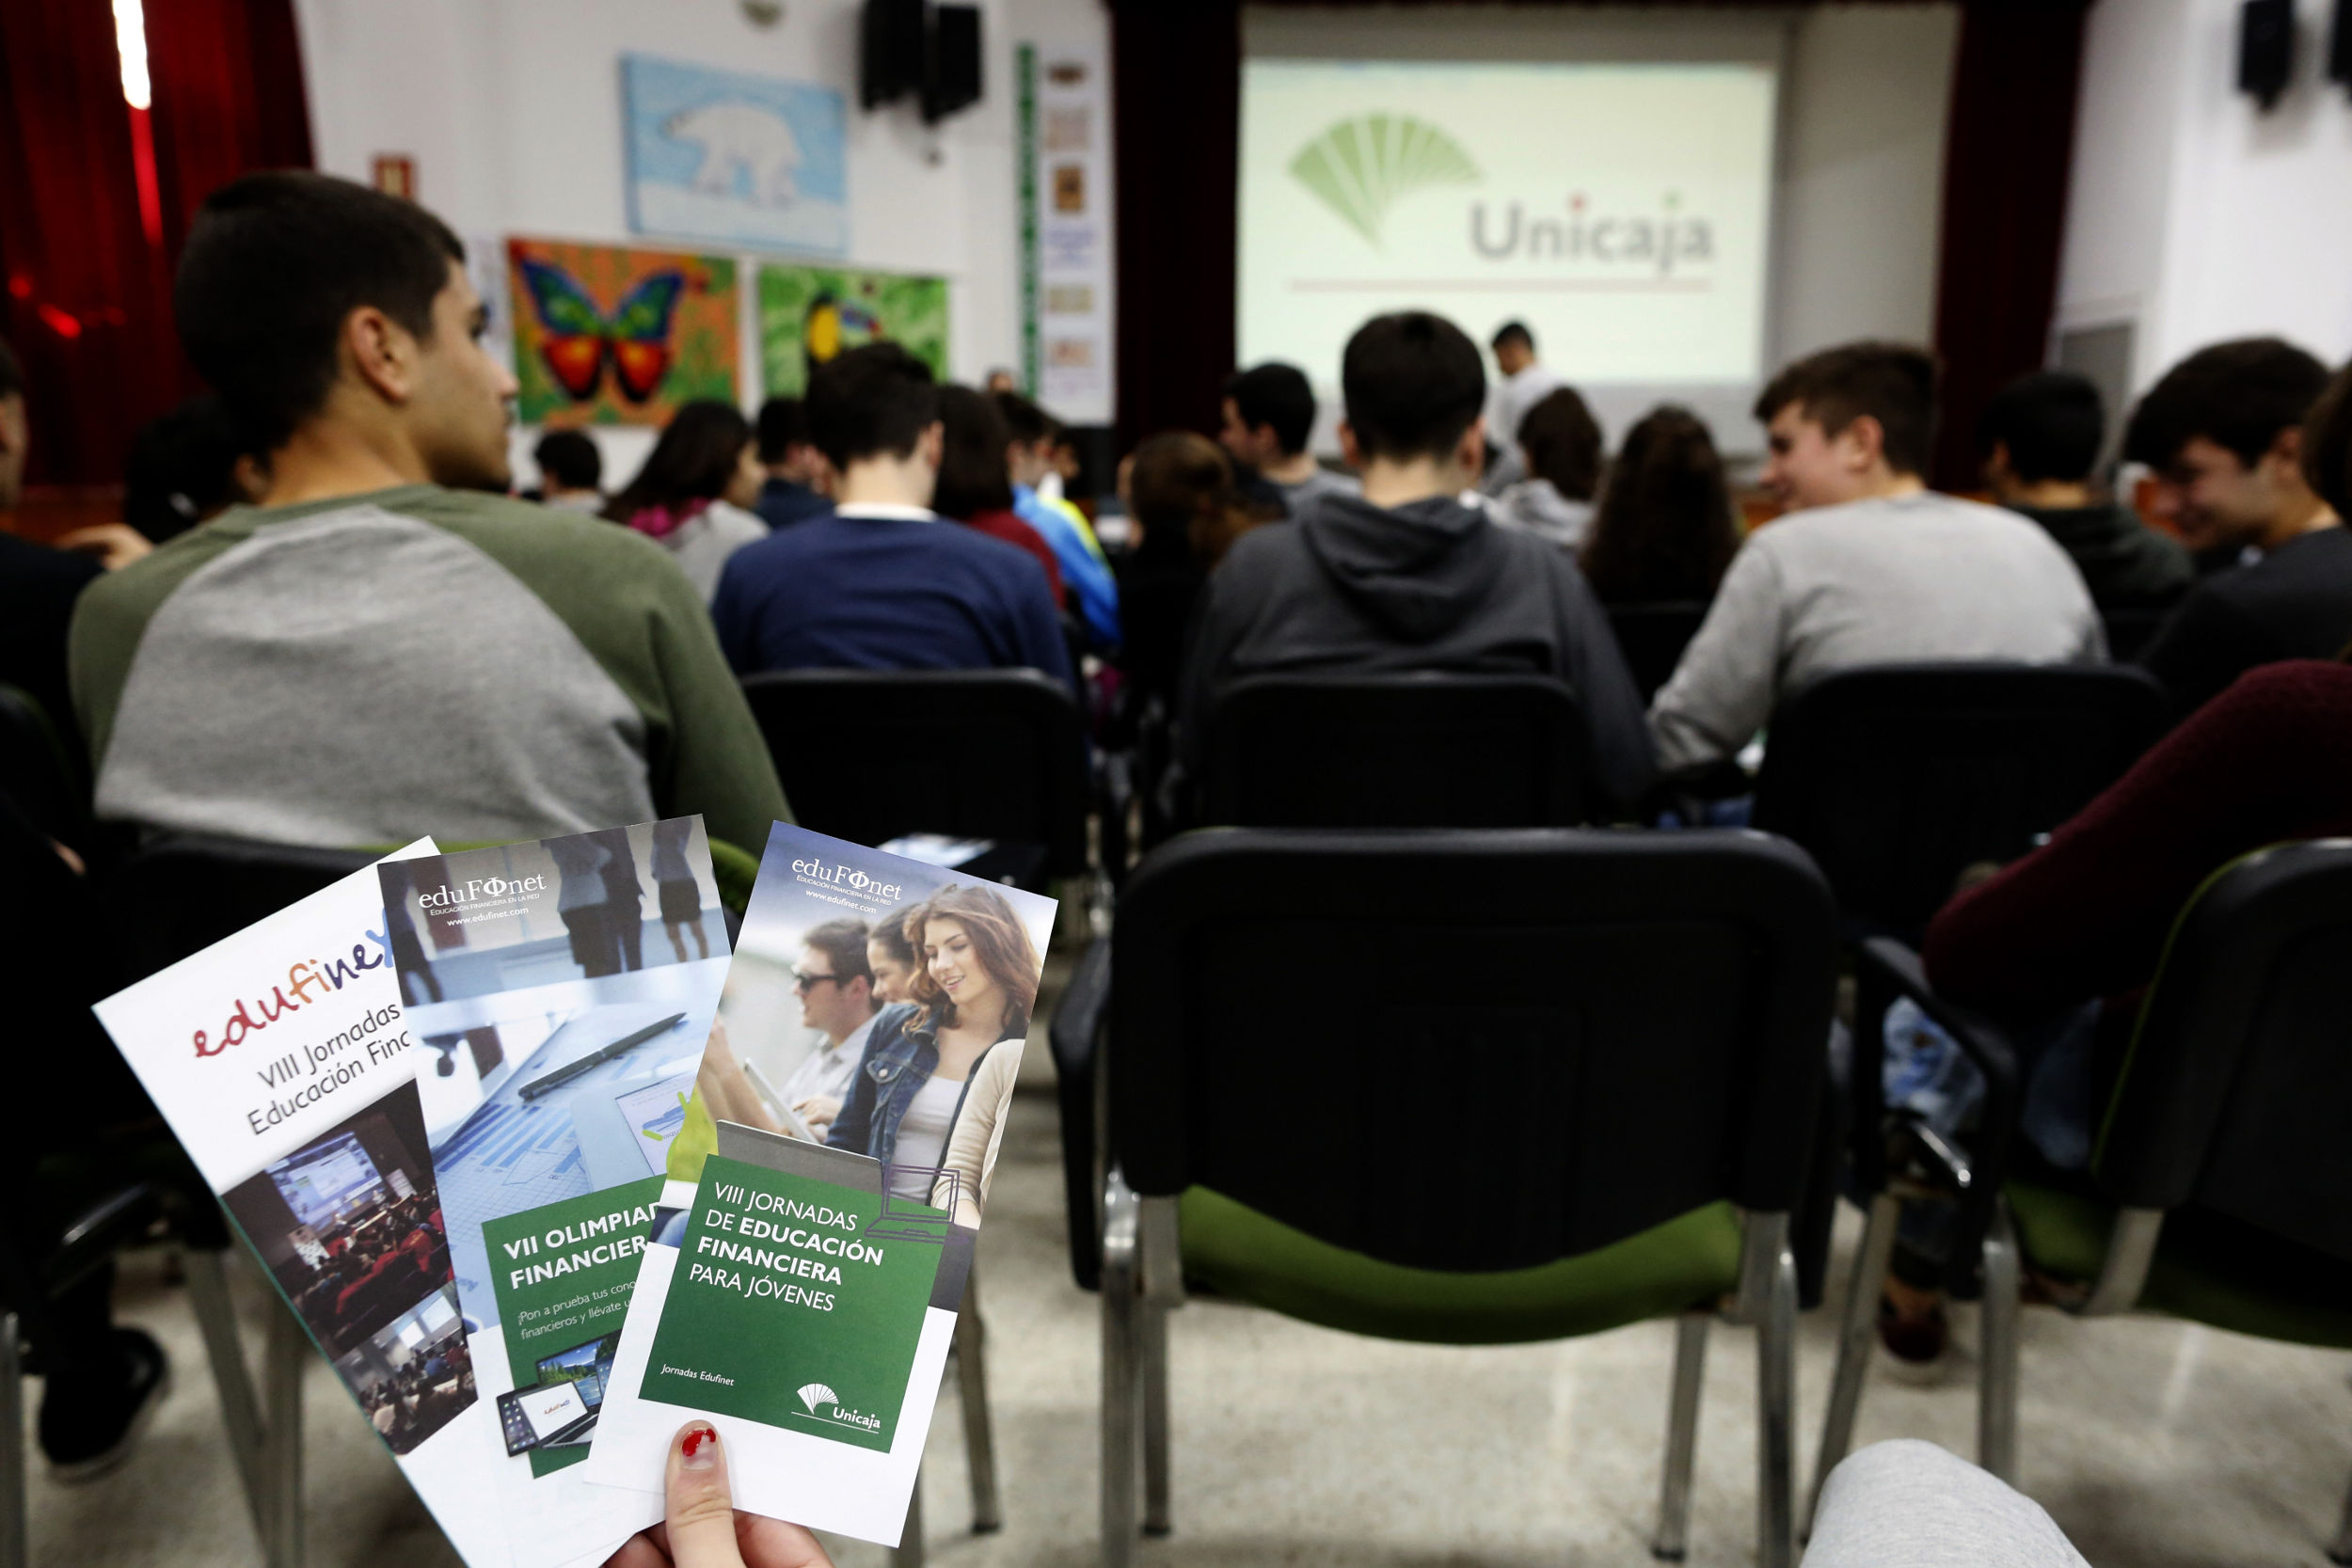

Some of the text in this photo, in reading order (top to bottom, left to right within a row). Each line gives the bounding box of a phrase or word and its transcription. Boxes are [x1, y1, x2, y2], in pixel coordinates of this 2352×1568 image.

[1470, 189, 1714, 275] Unicaja
[447, 907, 529, 927] www.edufinet.com
[805, 890, 877, 914] www.edufinet.com
[258, 1004, 400, 1088] VIII Jornadas
[246, 1059, 364, 1135] Educación
[715, 1181, 858, 1231] VIII JORNADAS
[503, 1236, 539, 1260] VII
[705, 1209, 883, 1266] DE EDUCACIÓN
[697, 1235, 842, 1285] FINANCIERA
[544, 1307, 550, 1316] a
[552, 1295, 590, 1315] prueba
[592, 1289, 609, 1300] tus
[689, 1262, 835, 1311] PARA JÓVENES
[520, 1316, 578, 1339] financieros
[580, 1313, 586, 1324] y
[589, 1303, 621, 1319] llévate
[660, 1364, 735, 1386] Jornadas Edufinet
[833, 1406, 882, 1430] Unicaja
